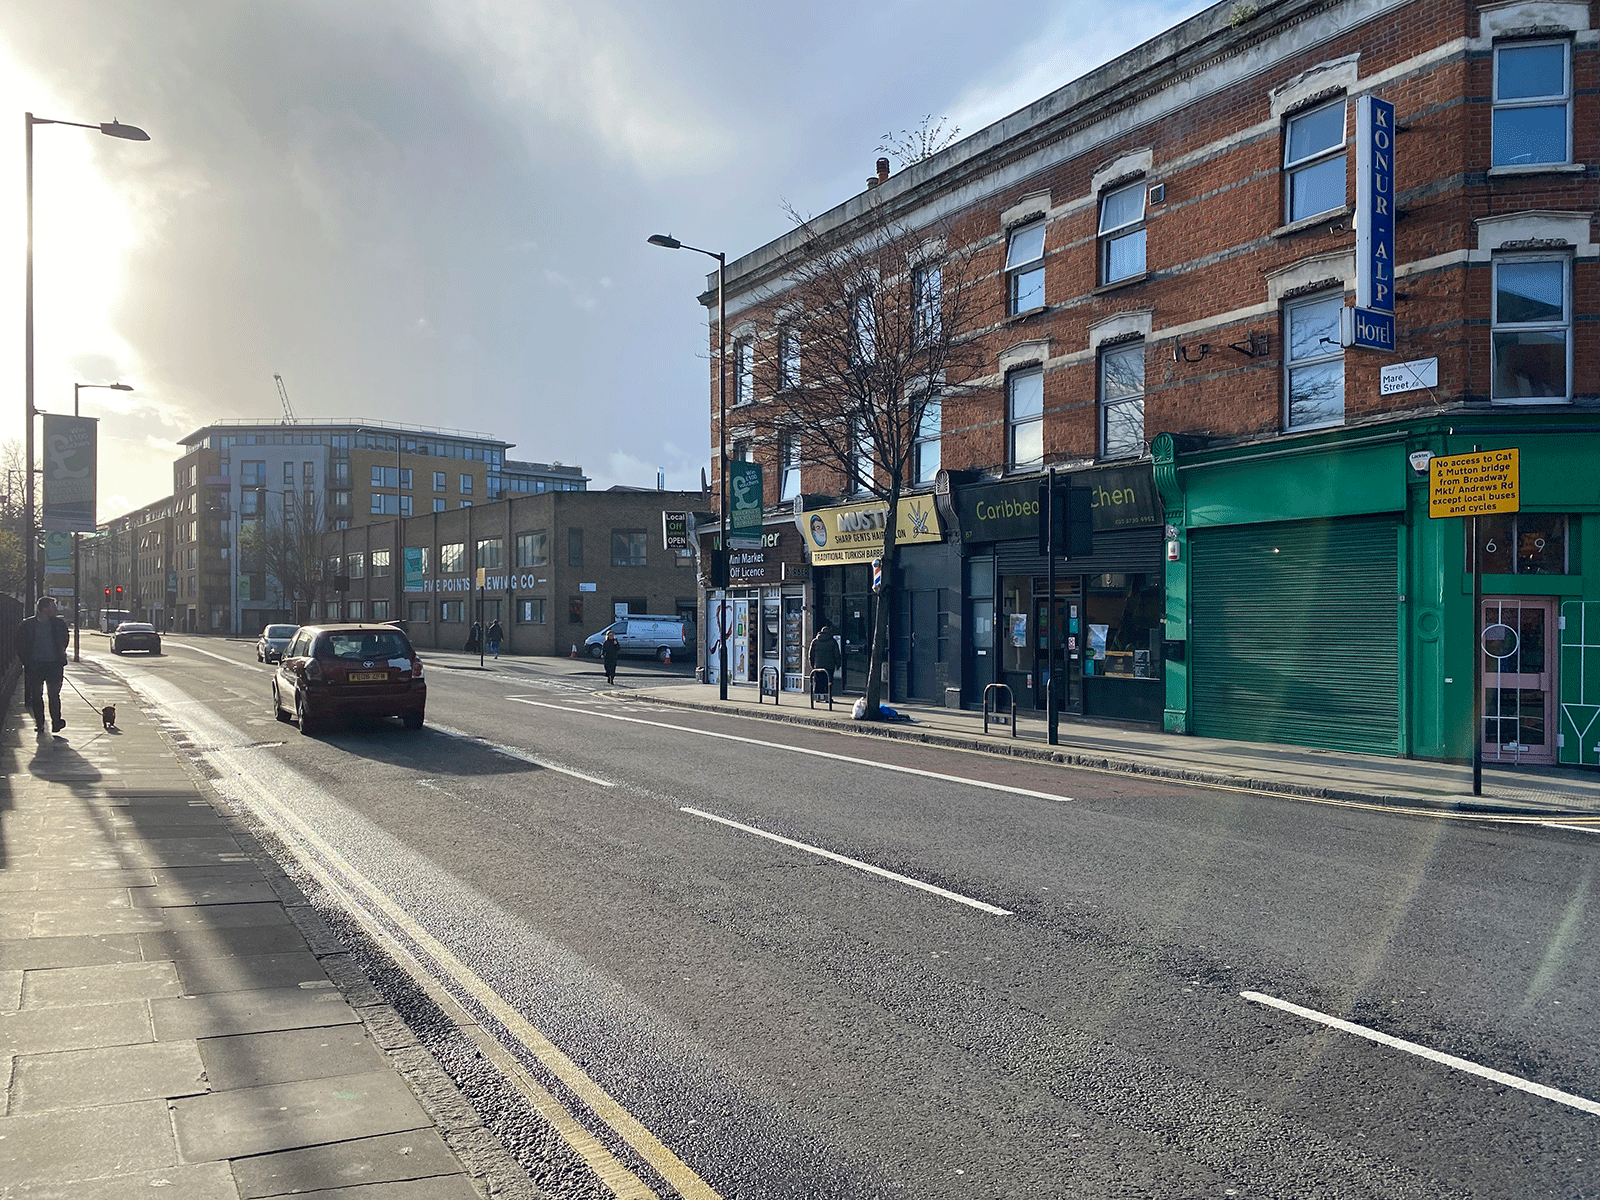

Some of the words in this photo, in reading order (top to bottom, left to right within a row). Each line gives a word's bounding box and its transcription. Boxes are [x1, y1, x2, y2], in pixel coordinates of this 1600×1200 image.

[1375, 107, 1389, 216] KONUR
[1375, 241, 1389, 302] ALP
[1383, 374, 1403, 384] Mare
[1383, 381, 1409, 392] Street
[69, 433, 88, 442] £100
[58, 441, 91, 450] vouchers
[1436, 460, 1448, 468] No
[1451, 457, 1480, 466] access
[1483, 455, 1493, 463] to
[1495, 453, 1512, 461] Cat
[1446, 467, 1478, 476] Mutton
[1481, 463, 1510, 473] bridge
[1439, 478, 1460, 486] from
[1463, 473, 1508, 484] Broadway
[1435, 486, 1455, 496] Mkt/
[1458, 484, 1497, 494] Andrews
[1500, 481, 1514, 489] Rd
[976, 498, 1040, 521] Caribbea
[1091, 485, 1135, 507] chen
[1432, 496, 1461, 506] except
[1464, 493, 1486, 502] local
[1488, 492, 1516, 500] buses
[1449, 505, 1466, 513] and
[1468, 503, 1497, 512] cycles
[665, 513, 686, 521] Local
[669, 522, 683, 530] Off
[667, 536, 686, 544] OPEN
[834, 534, 852, 544] SHARP
[853, 532, 871, 542] GENTS
[1486, 538, 1497, 554] 6
[1534, 537, 1545, 553] 9
[741, 552, 764, 563] Market
[814, 551, 844, 562] TRADITIONAL
[844, 550, 866, 560] TURKISH
[730, 567, 740, 578] Off
[741, 566, 765, 577] Licence
[442, 577, 470, 592] POINTS
[520, 573, 535, 589] CO
